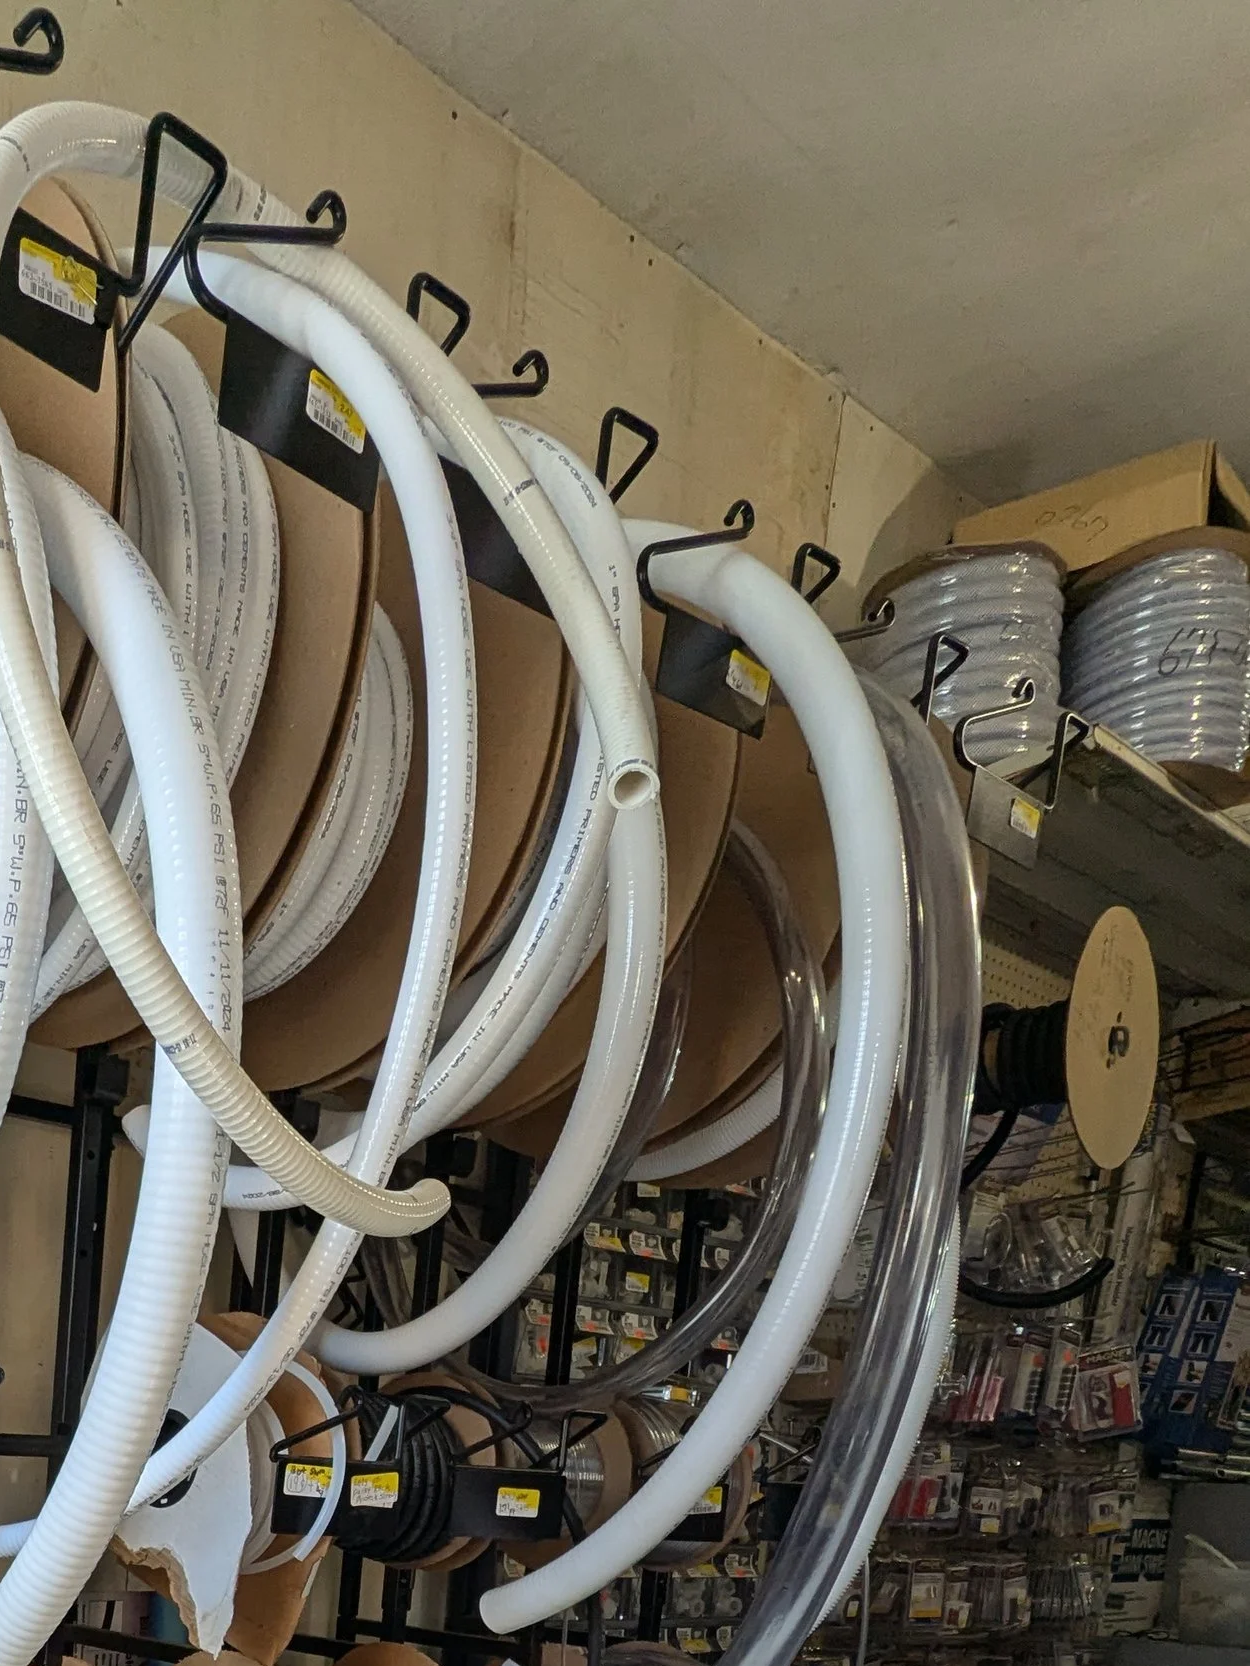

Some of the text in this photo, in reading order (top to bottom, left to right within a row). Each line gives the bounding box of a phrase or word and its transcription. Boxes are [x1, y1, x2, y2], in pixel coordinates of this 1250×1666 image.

[182, 502, 192, 540] HOSE
[185, 547, 193, 577] USE
[184, 582, 193, 624] WITH
[218, 501, 249, 698] AND CEMENTS MADE IN USA
[611, 586, 621, 613] SPA
[161, 622, 176, 642] IN
[459, 597, 471, 640] HOSE
[168, 644, 186, 676] USA
[259, 628, 271, 668] WITH
[463, 647, 474, 680] USE
[244, 672, 262, 727] LISTED
[465, 688, 475, 736] WITH
[463, 741, 475, 806] LISTED
[212, 832, 227, 866] PSI
[455, 812, 471, 888] PRIMERS
[563, 808, 593, 876] PRIMERS
[450, 897, 460, 930] AND
[549, 881, 565, 912] AND
[513, 917, 550, 981] CEMENTS
[216, 929, 233, 1034] 11/11/2024
[432, 938, 453, 1012] CEMENTS
[485, 985, 514, 1020] MADE
[419, 1019, 436, 1061] MADE
[469, 1026, 487, 1045] IN
[450, 1045, 472, 1070] USA
[411, 1071, 421, 1089] IN
[398, 1096, 415, 1128] USA
[211, 1129, 225, 1184] 1-1/2
[206, 1193, 219, 1226] SPA
[335, 1250, 352, 1275] 100
[320, 1280, 336, 1304] PSI
